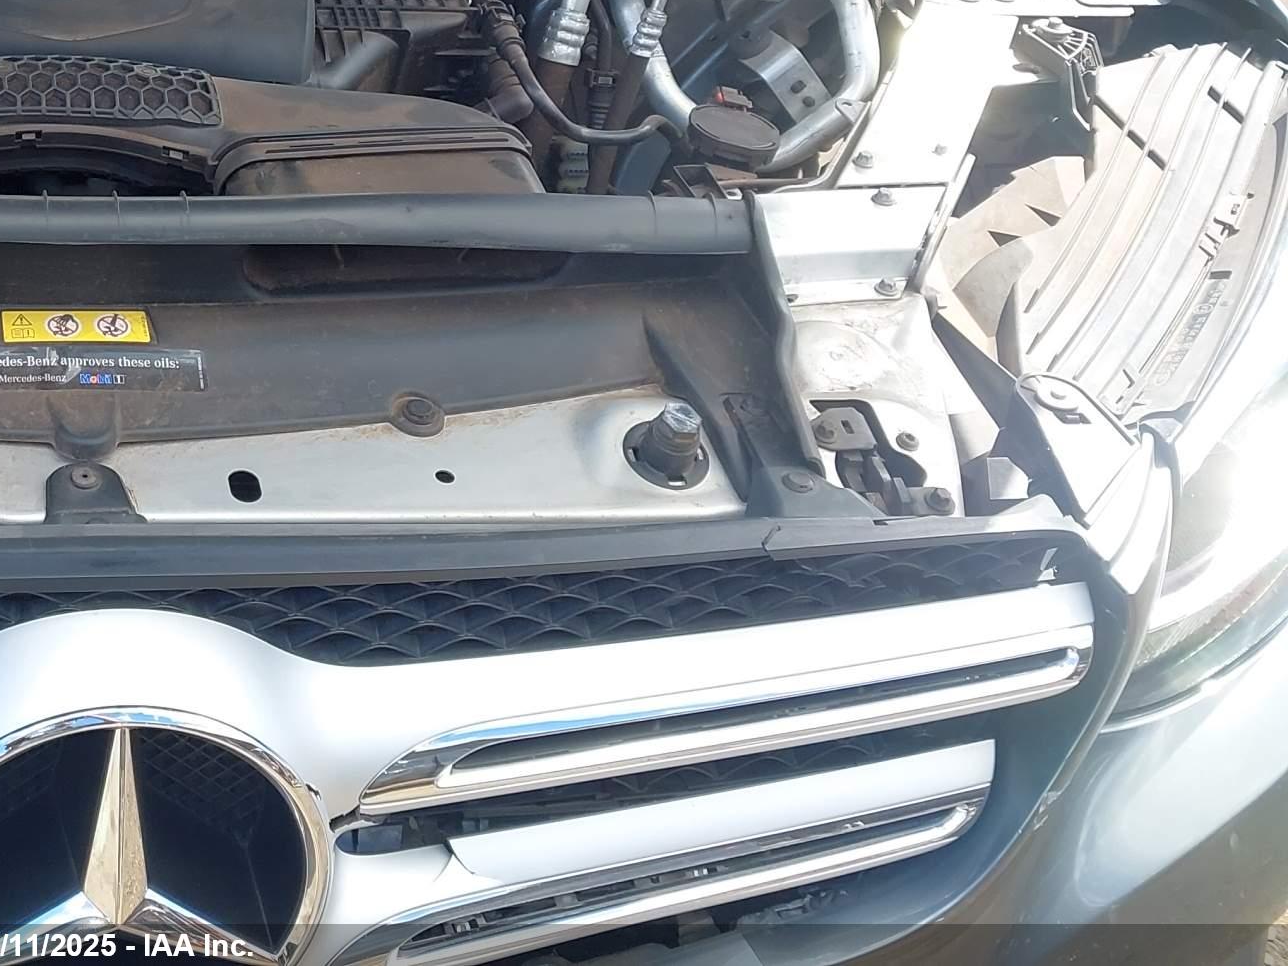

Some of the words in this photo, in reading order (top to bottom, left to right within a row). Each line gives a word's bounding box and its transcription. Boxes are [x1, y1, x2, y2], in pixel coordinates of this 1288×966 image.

[60, 357, 115, 372] approves
[118, 356, 151, 368] these
[154, 357, 180, 369] oils:
[79, 373, 112, 384] Mobil
